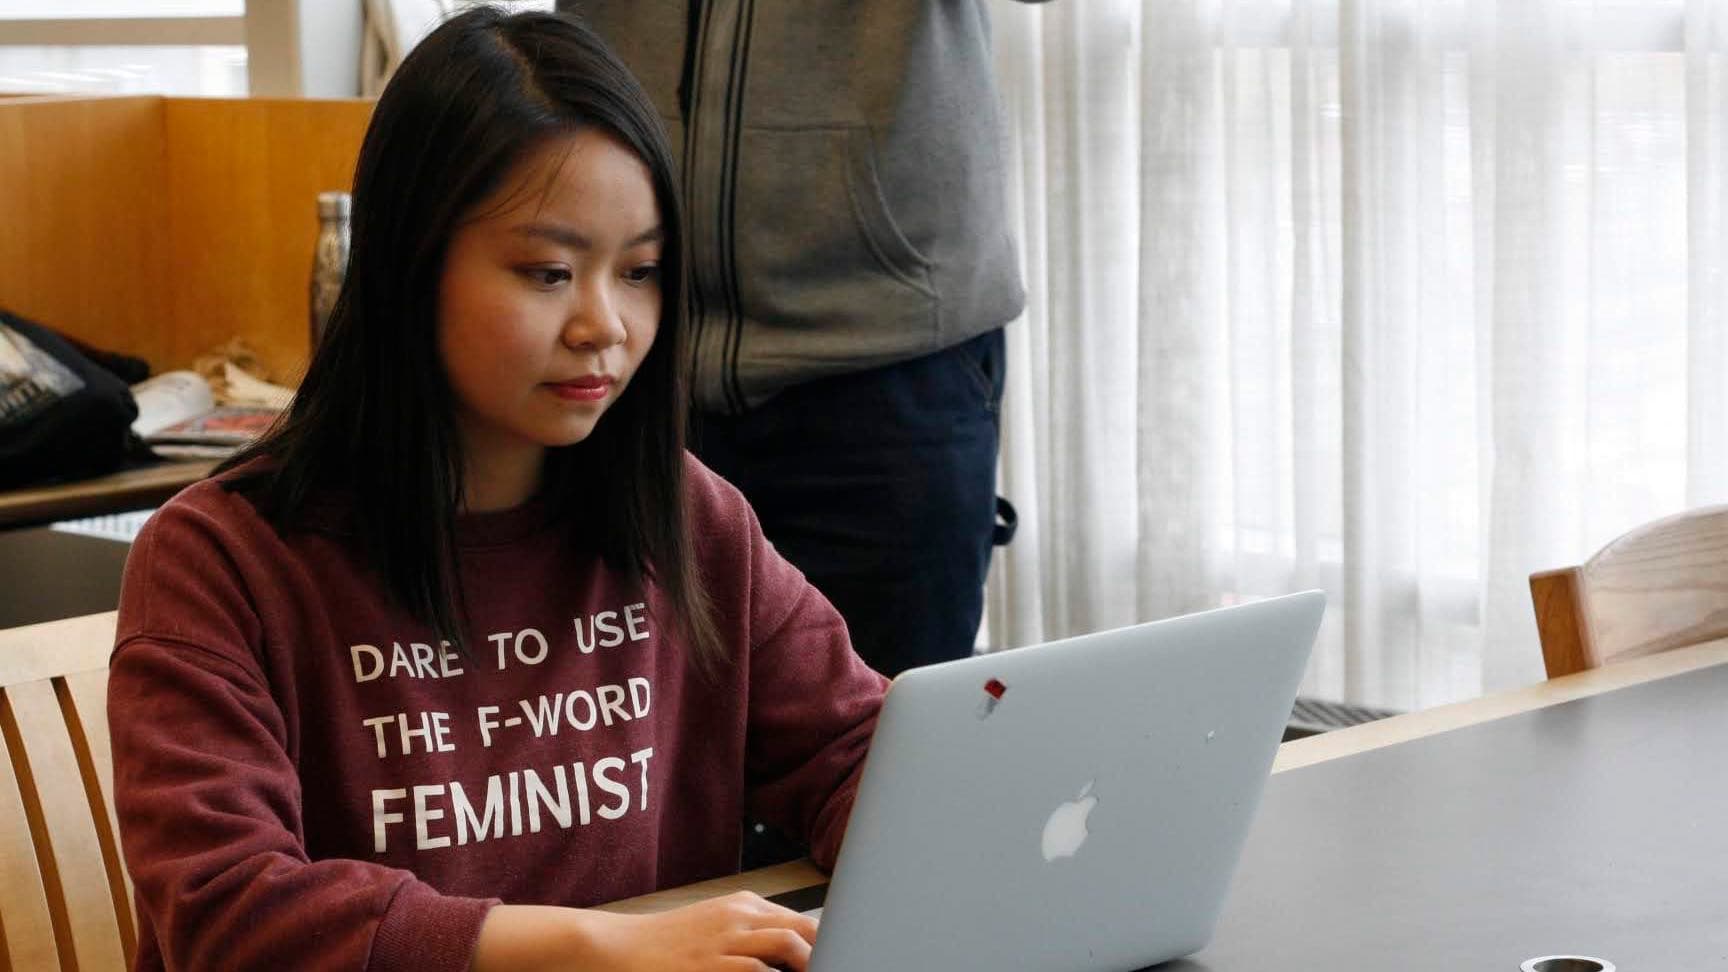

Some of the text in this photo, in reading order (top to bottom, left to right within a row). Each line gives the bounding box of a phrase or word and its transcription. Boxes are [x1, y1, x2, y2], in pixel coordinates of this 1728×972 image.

[351, 603, 650, 683] DARE TO USE
[363, 677, 651, 759] THE F-WORD
[371, 747, 653, 854] FEMINIST
